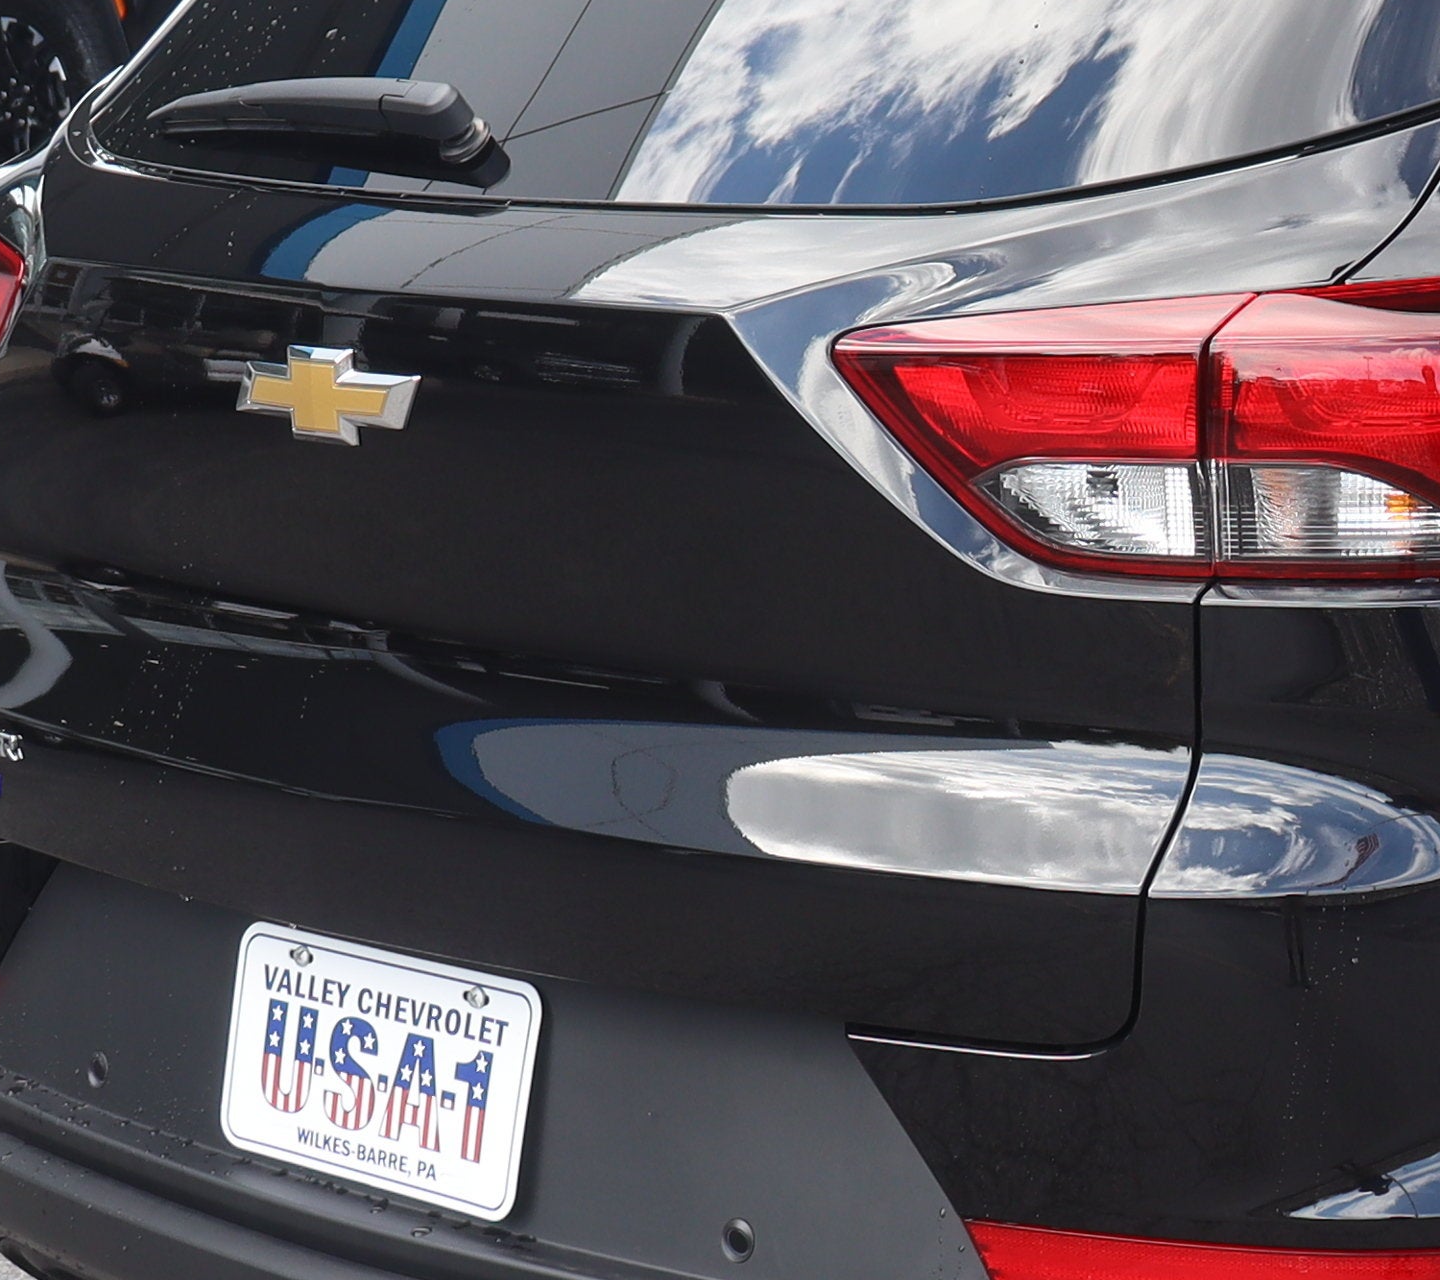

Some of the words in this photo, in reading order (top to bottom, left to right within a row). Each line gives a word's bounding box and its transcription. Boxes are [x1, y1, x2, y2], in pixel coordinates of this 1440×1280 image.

[264, 964, 351, 1008] VALLEY
[357, 987, 509, 1047] CHEVROLET
[297, 1126, 411, 1179] WILKES-BARRE,
[417, 1160, 438, 1181] PA
